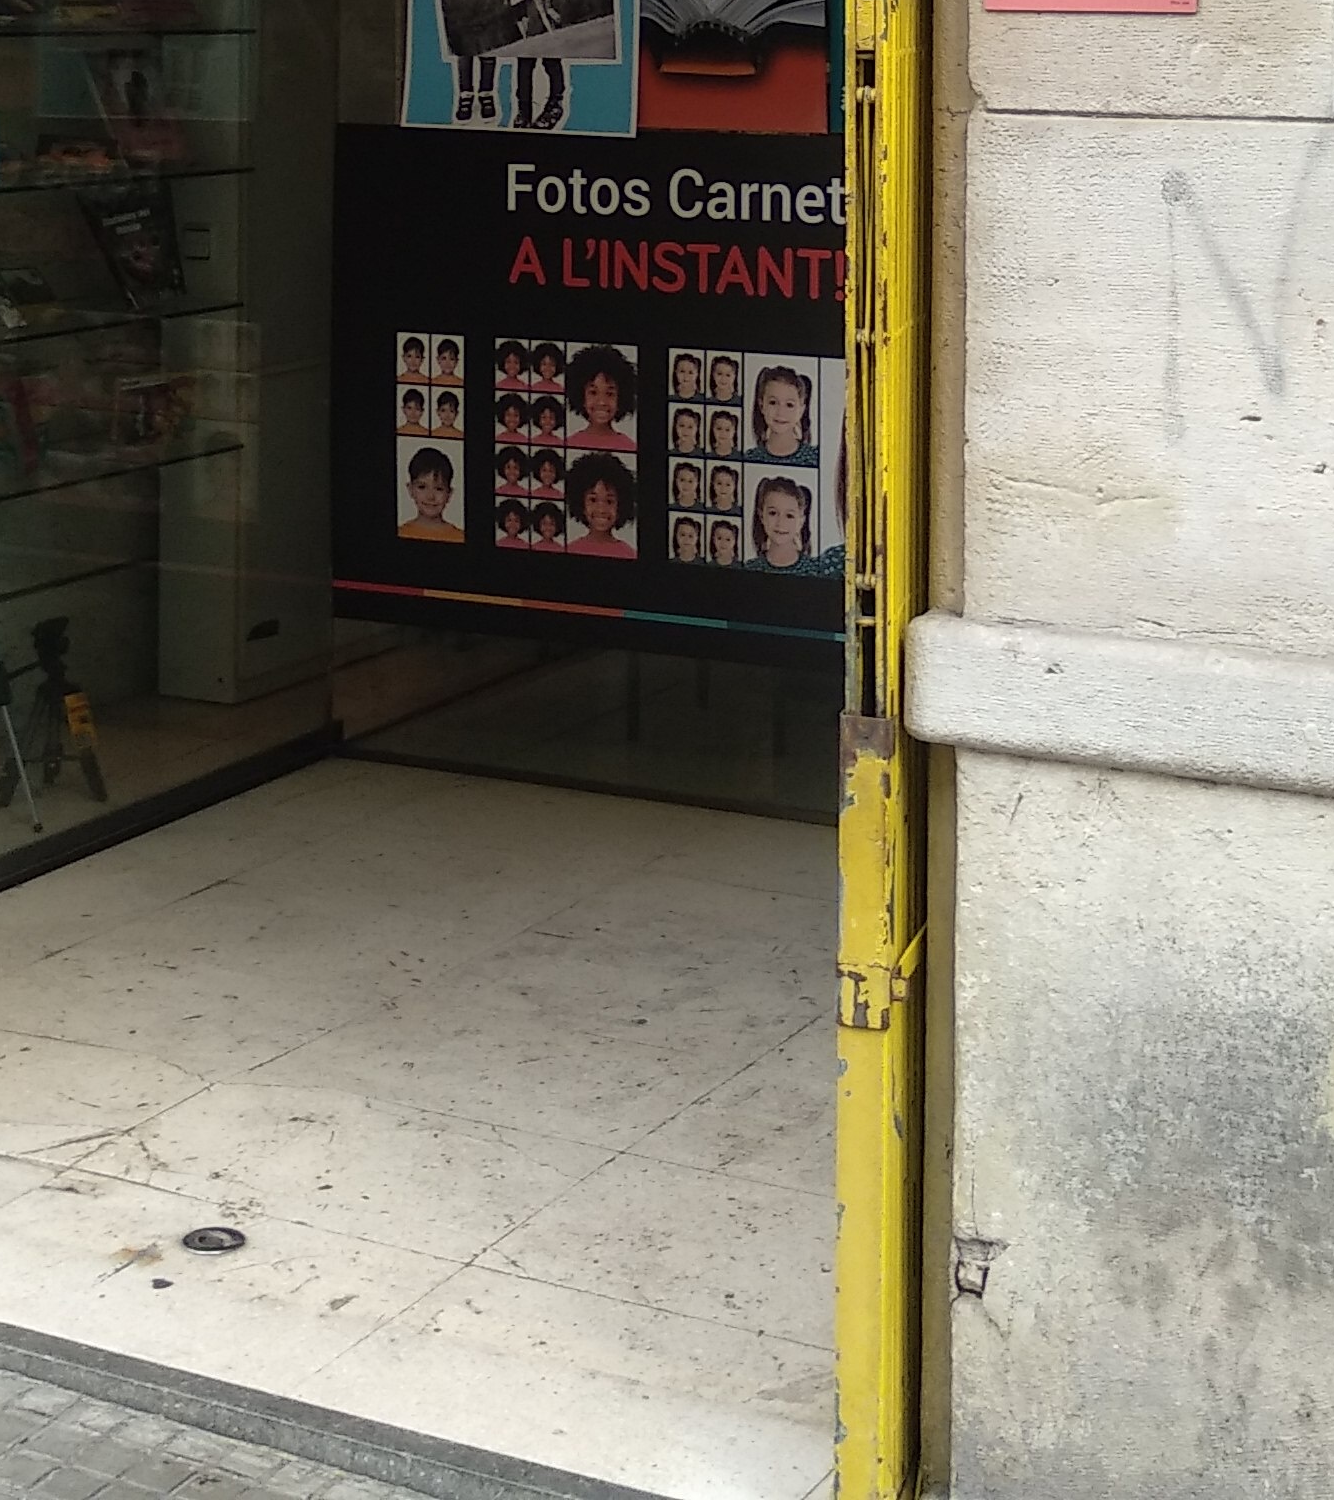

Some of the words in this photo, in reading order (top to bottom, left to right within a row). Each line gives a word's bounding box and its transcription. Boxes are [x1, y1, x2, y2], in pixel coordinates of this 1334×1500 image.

[507, 164, 651, 217] Fotos
[669, 168, 845, 225] Carnet
[509, 236, 546, 284] A
